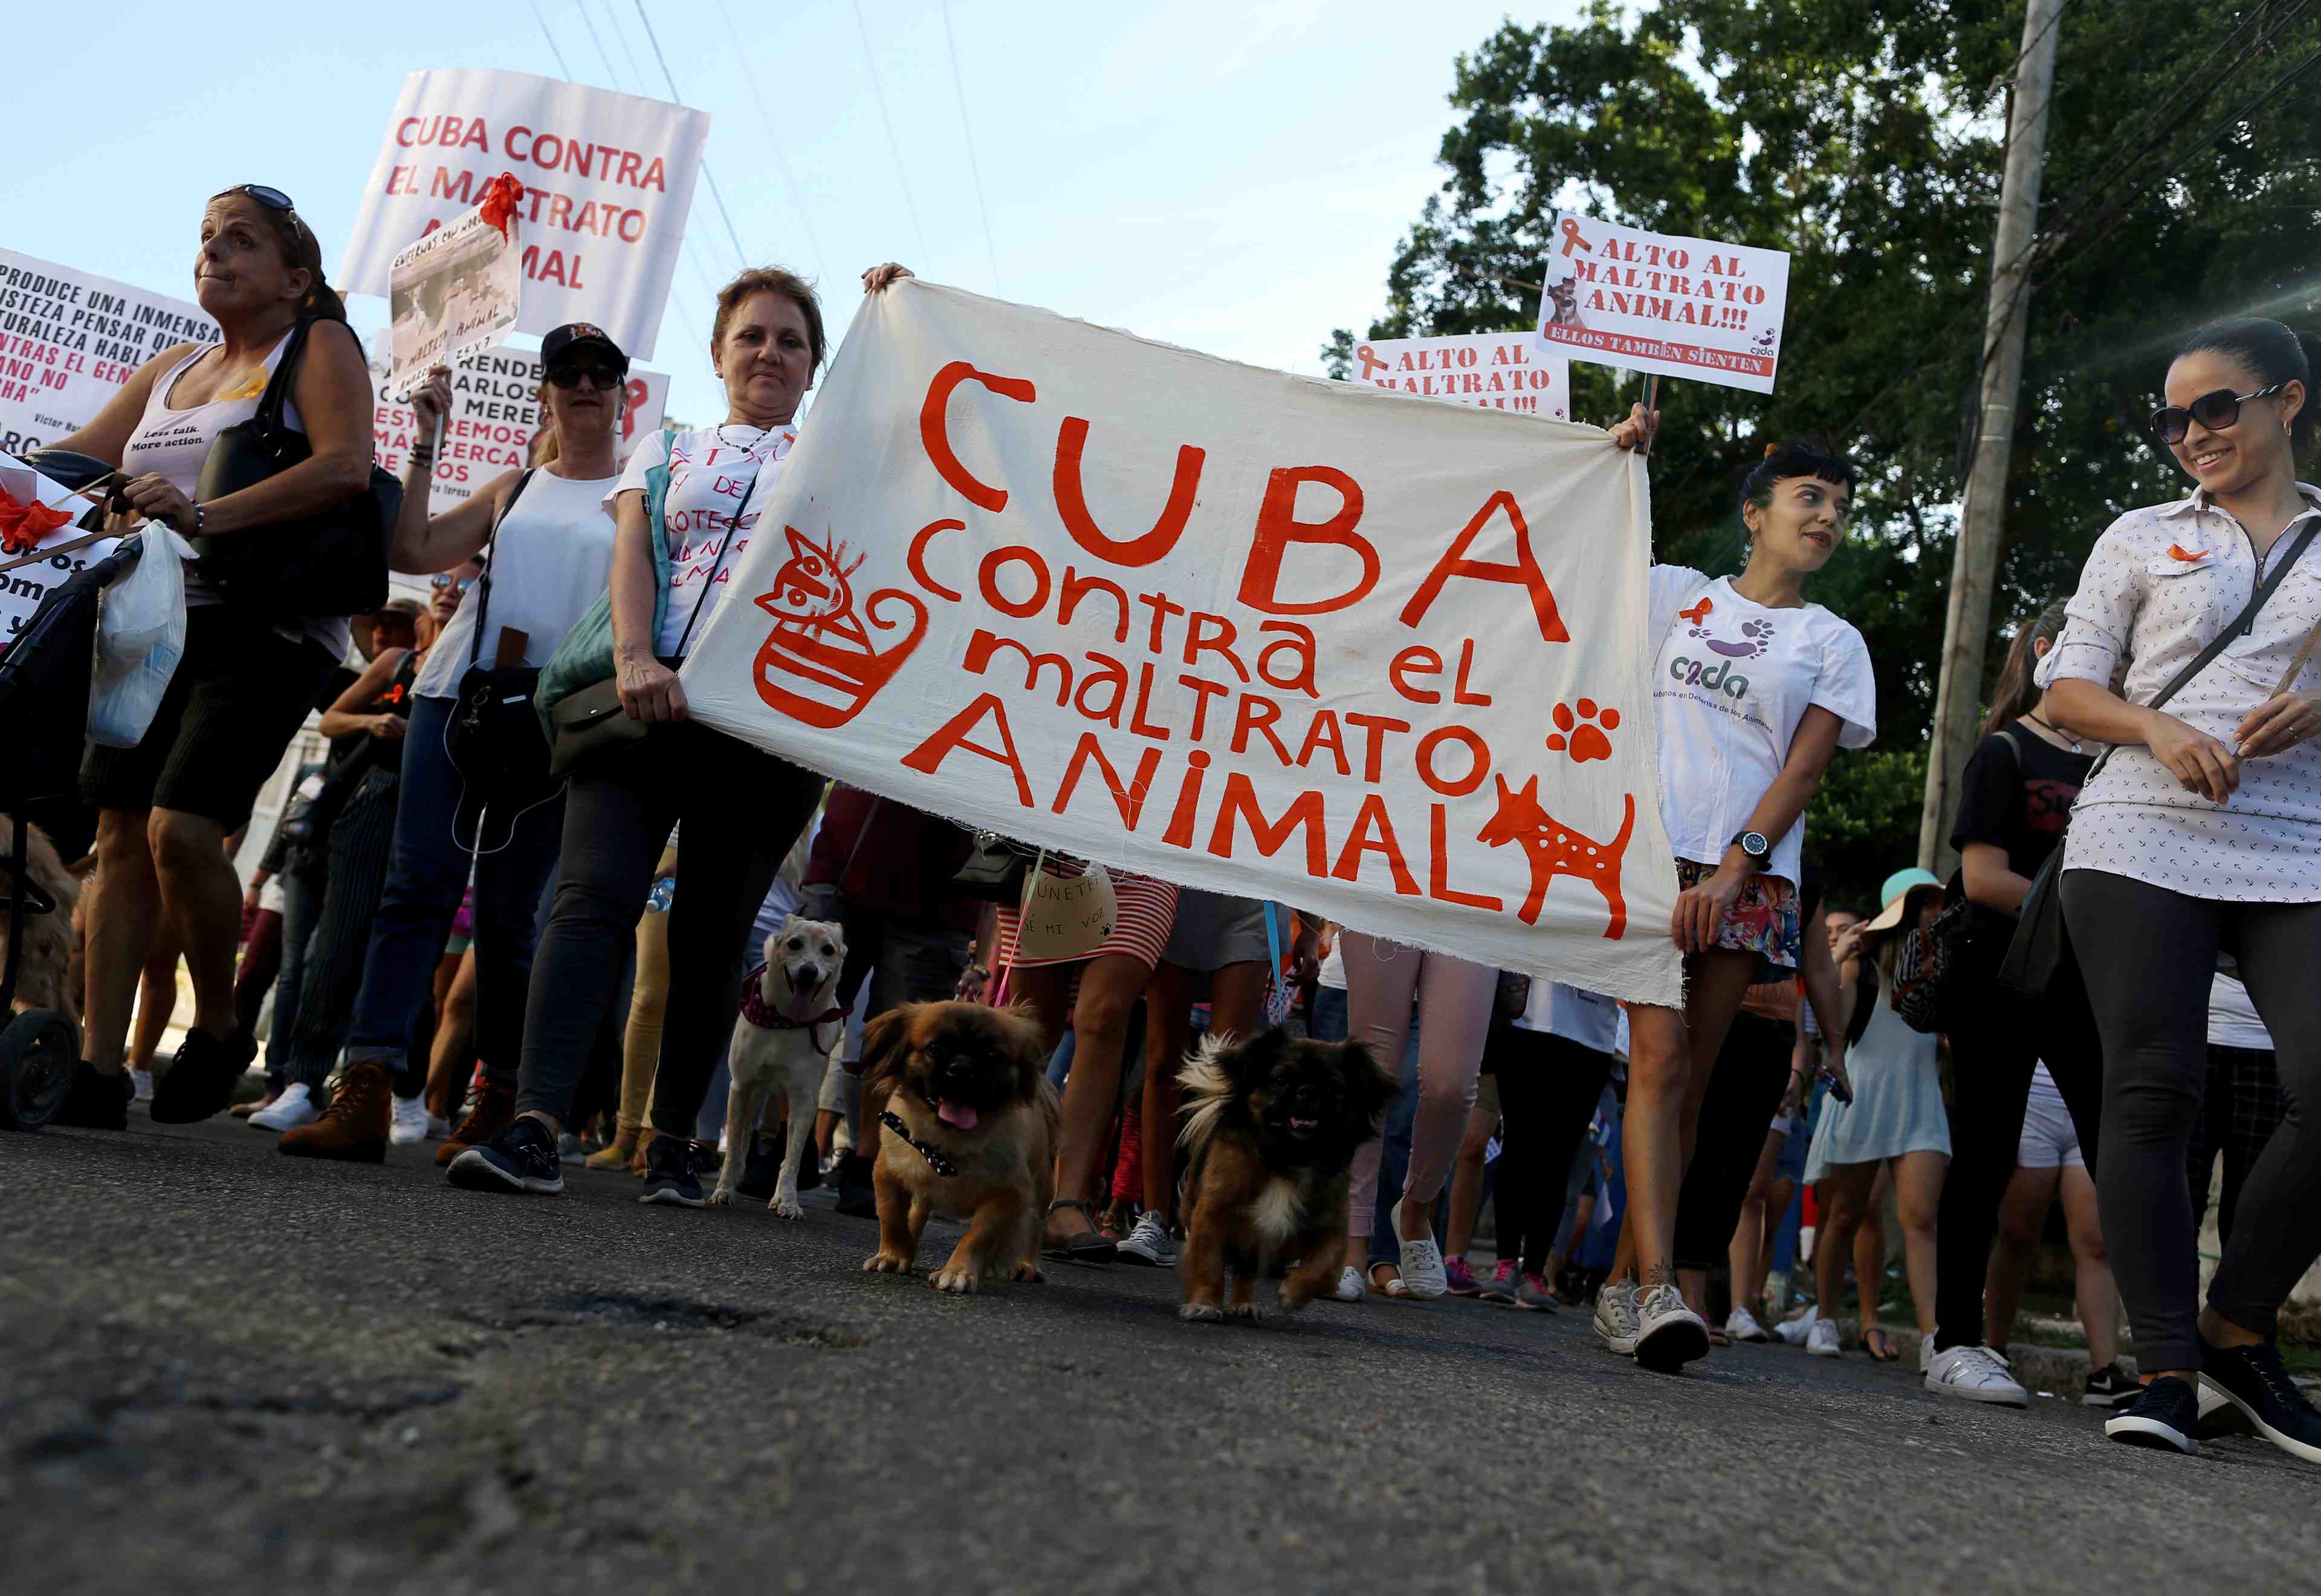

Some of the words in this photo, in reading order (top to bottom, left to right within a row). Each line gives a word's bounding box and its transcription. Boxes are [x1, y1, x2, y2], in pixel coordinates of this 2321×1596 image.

[397, 115, 489, 152] CUBA
[504, 125, 666, 193] CONTRA
[386, 166, 419, 195] EL
[430, 166, 647, 244] MATRATO
[1599, 237, 1689, 270] ALTO
[1702, 254, 1746, 277] AL
[1573, 258, 1766, 305] MALTRATO
[0, 264, 82, 304] PRODUCE
[88, 291, 126, 316] UNA
[132, 303, 222, 343] INMENSA
[1584, 288, 1749, 331] ANIMAL!!!
[71, 309, 147, 345] PENSAR
[152, 332, 189, 354] QU
[1550, 326, 1605, 347] ELLOS
[64, 352, 85, 373] EL
[1397, 347, 1478, 372] ALTO
[1491, 344, 1530, 366] AL
[40, 369, 68, 390] NO
[34, 413, 63, 428] Victor
[465, 398, 543, 425] MERE
[131, 442, 162, 452] More
[164, 436, 204, 447] action.
[143, 430, 170, 439] Less
[173, 425, 199, 435] talk.
[920, 361, 1570, 642] CUBA
[1719, 705, 1729, 714] de
